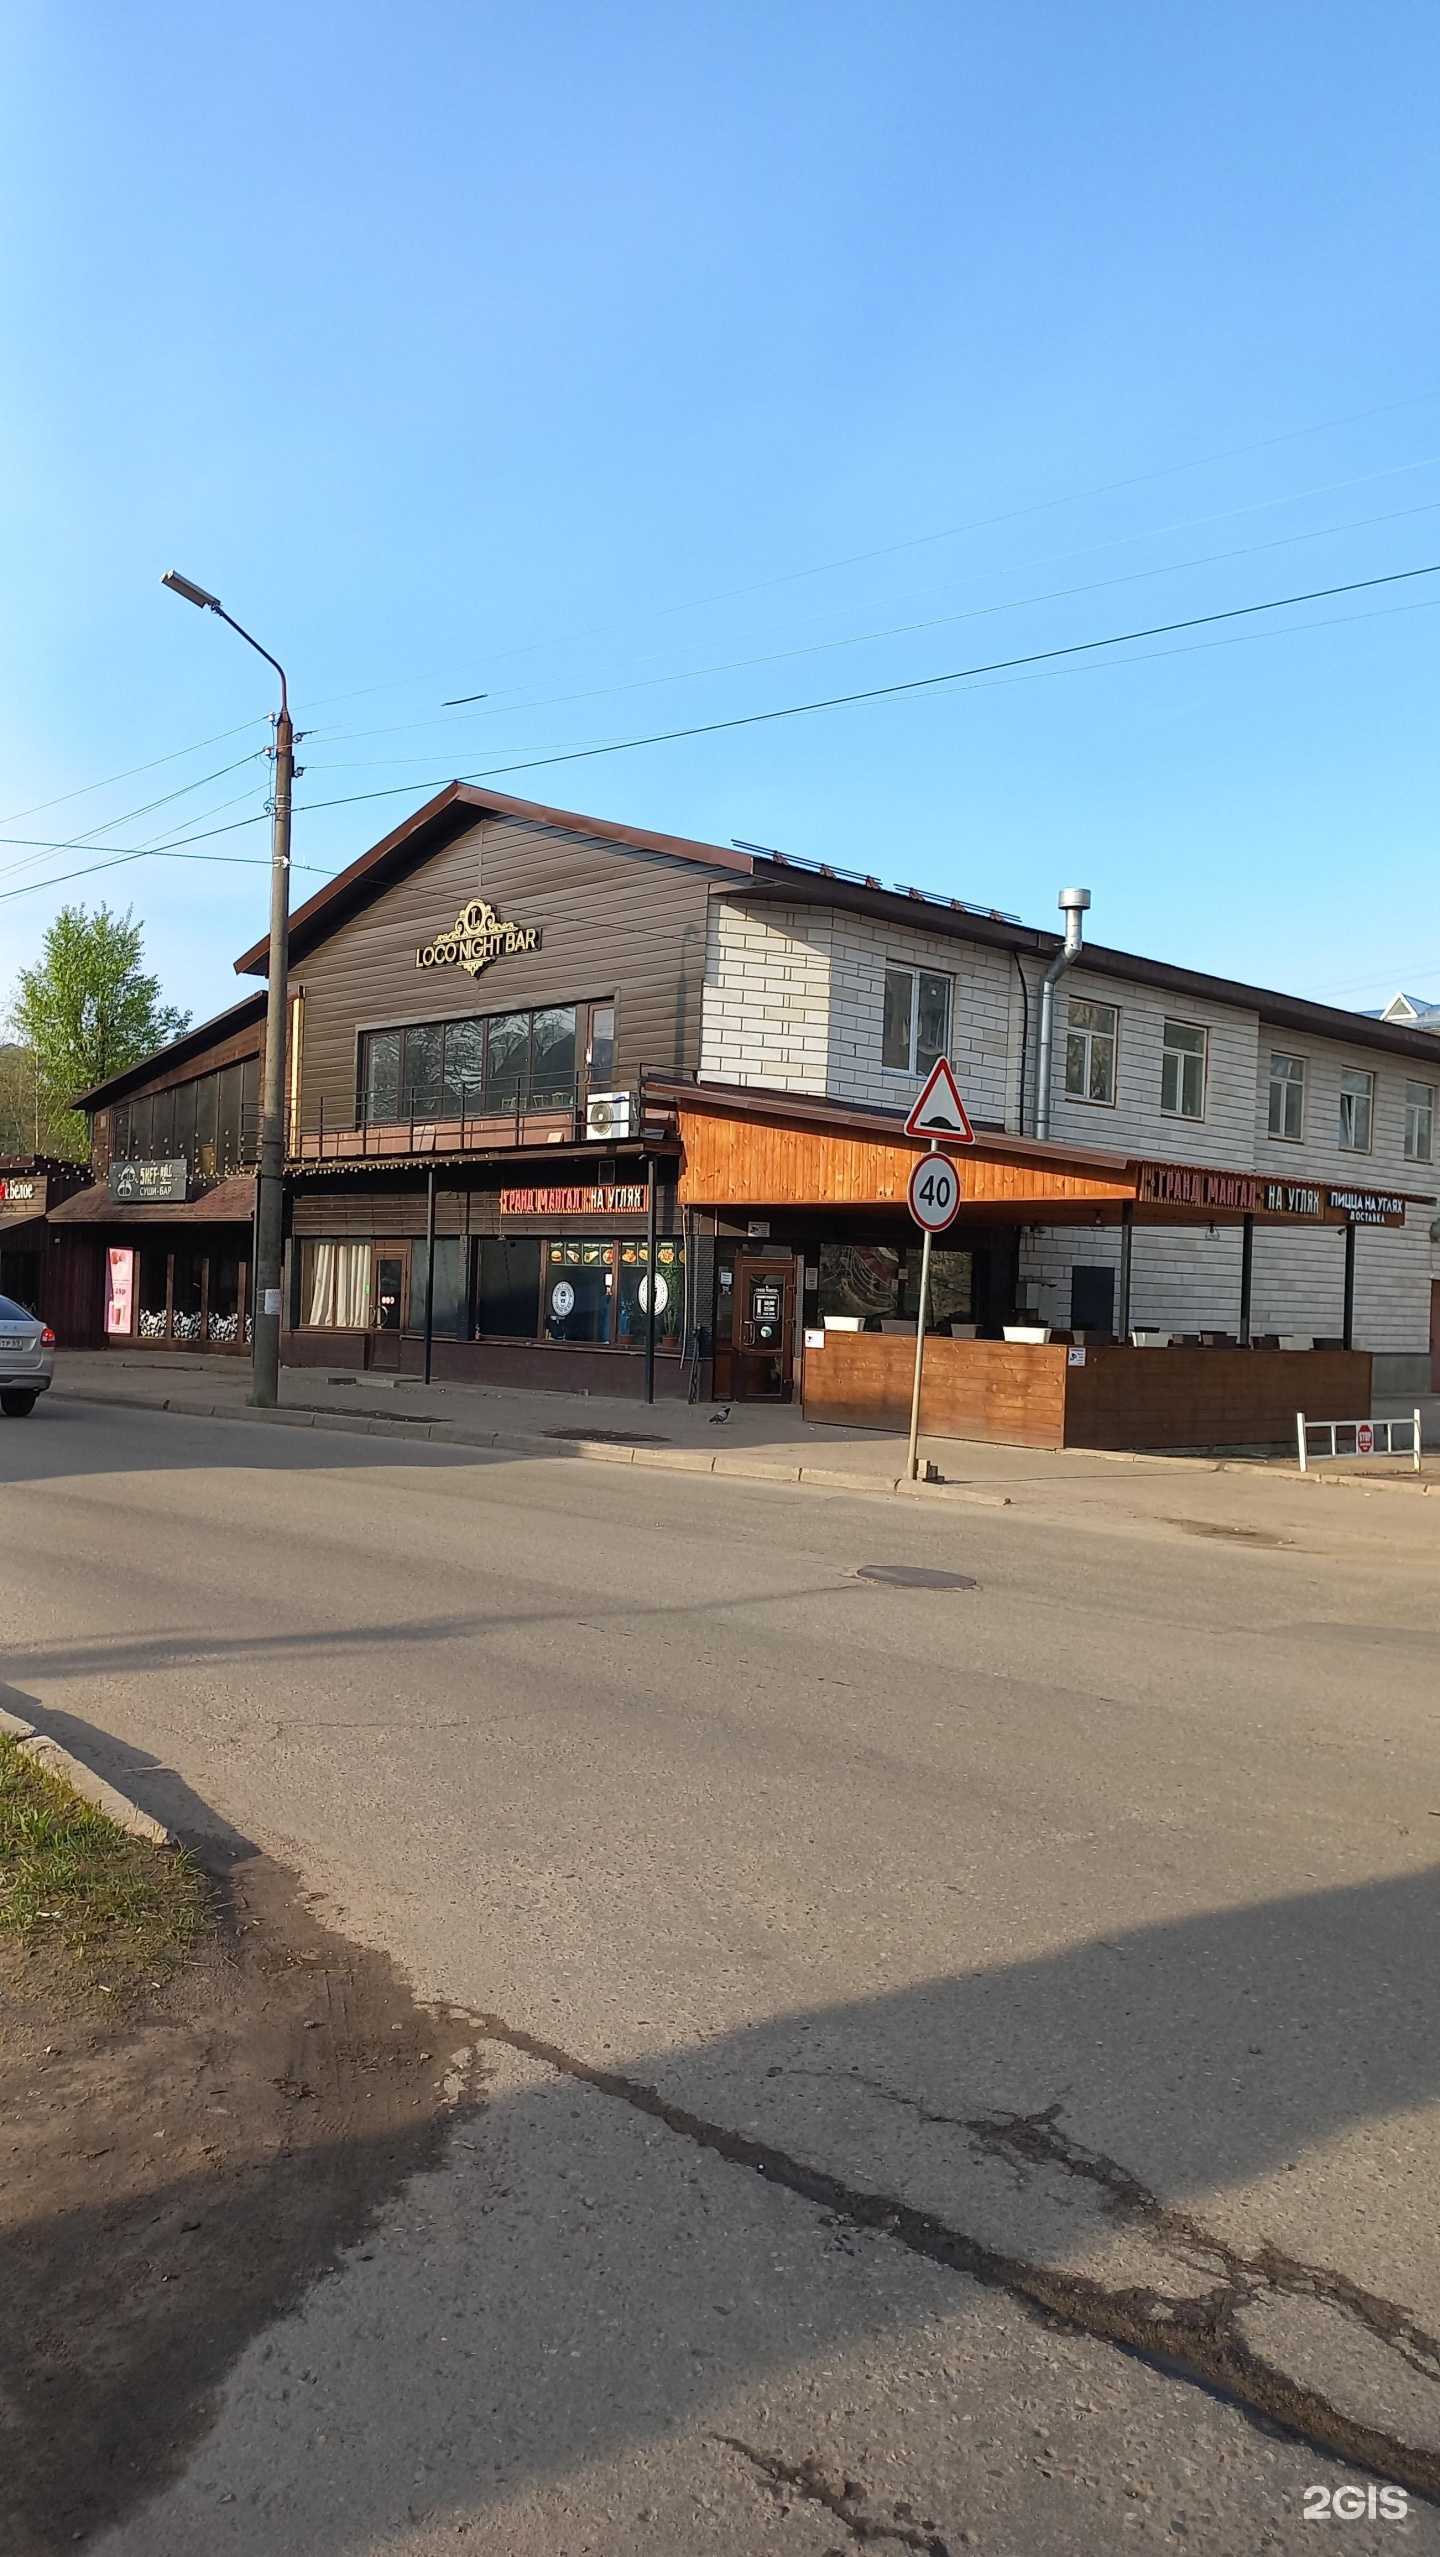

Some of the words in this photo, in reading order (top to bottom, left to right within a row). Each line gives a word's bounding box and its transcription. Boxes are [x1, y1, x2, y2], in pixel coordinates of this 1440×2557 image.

[416, 942, 457, 967] LOCO
[460, 933, 503, 959] NIGHT
[506, 928, 536, 953] BAR
[140, 1186, 172, 1197] СУШИ-БАР
[504, 1191, 534, 1212] ГРАНД
[538, 1189, 580, 1210] МАНГАЛ
[592, 1188, 604, 1208] НА
[608, 1188, 641, 1208] УГЛЯХ
[919, 1175, 950, 1207] 40
[1159, 1170, 1200, 1201] ГРАНД
[1207, 1176, 1256, 1208] МАНГАЛ
[1268, 1184, 1283, 1211] НА
[1288, 1187, 1320, 1214] УГЛЯХ
[1331, 1192, 1363, 1210] ПИЦЦА
[1364, 1197, 1377, 1212] НА
[1377, 1198, 1403, 1214] УГЛЯХ
[1350, 1210, 1386, 1224] ДОСТАВКА
